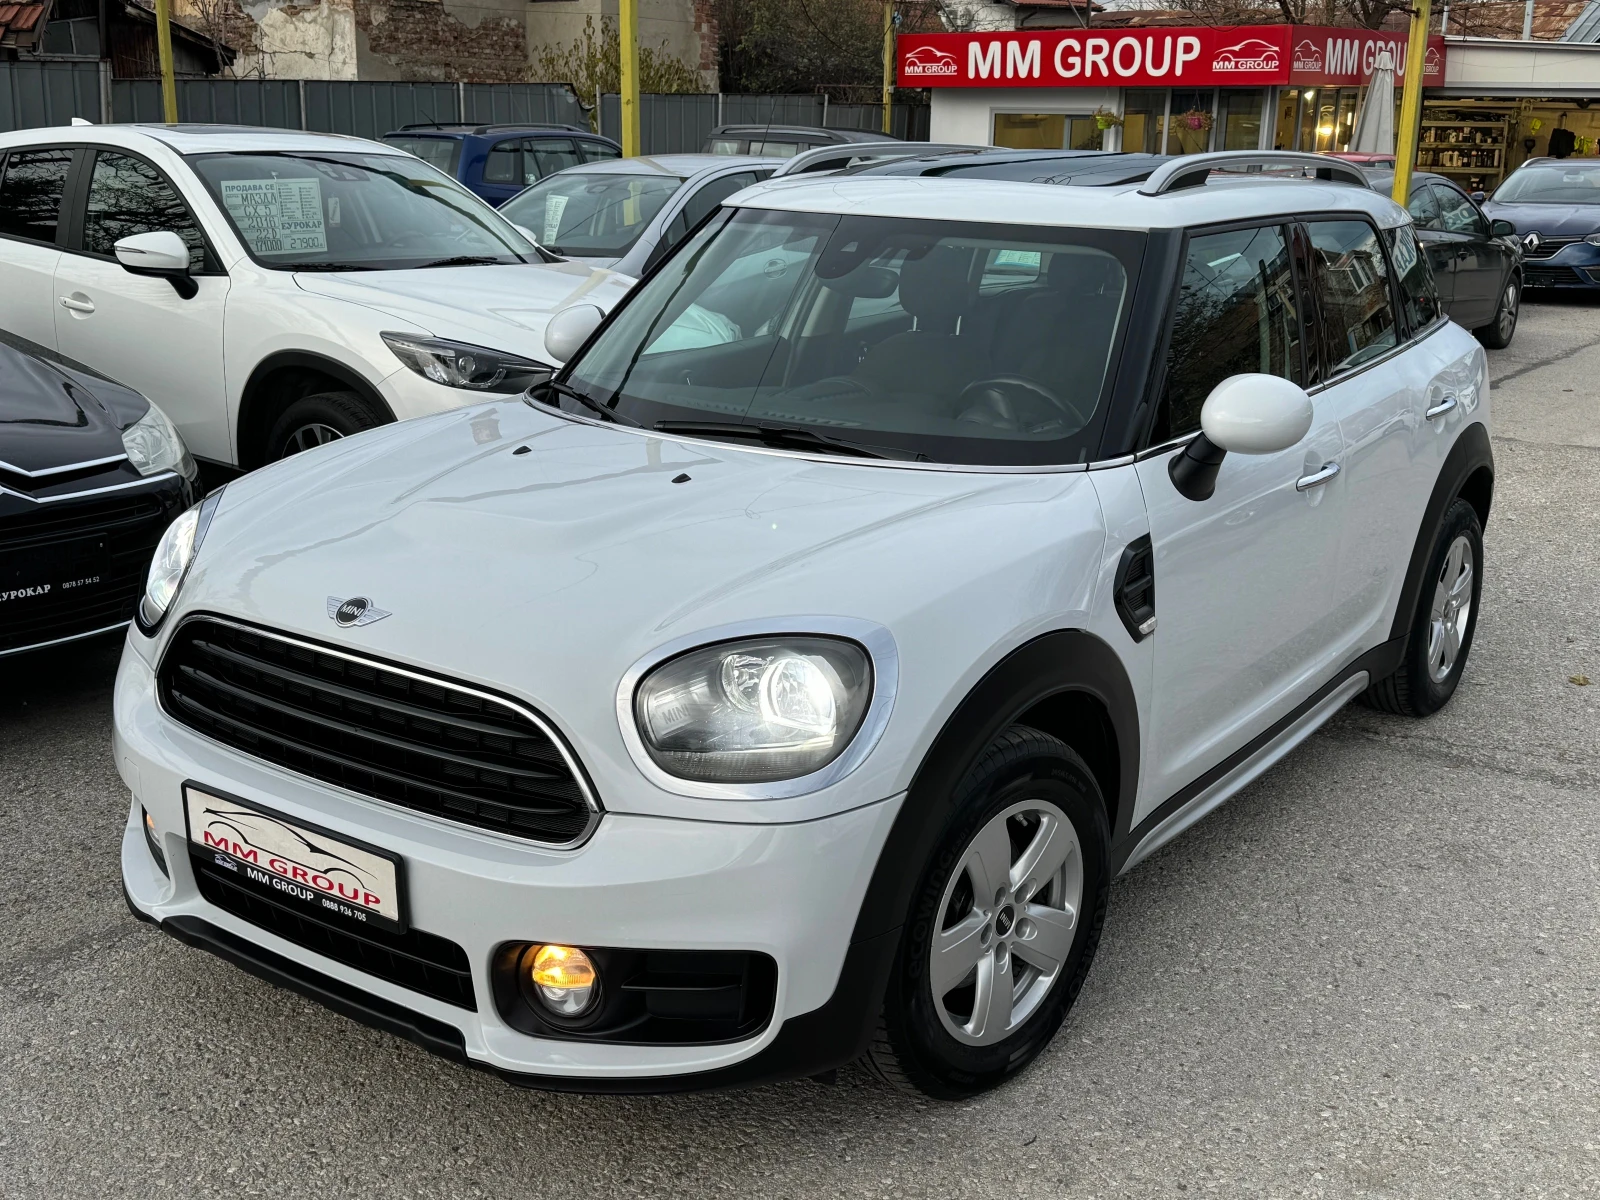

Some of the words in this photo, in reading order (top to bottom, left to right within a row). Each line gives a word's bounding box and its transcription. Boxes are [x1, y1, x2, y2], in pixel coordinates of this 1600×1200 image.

[968, 41, 1041, 79] MM
[1054, 36, 1200, 79] GROUP
[1324, 38, 1359, 76] MM
[1363, 40, 1407, 76] GOU
[905, 65, 923, 73] MM
[925, 65, 957, 74] GROUP
[1212, 60, 1235, 69] MM
[1238, 60, 1279, 69] GROUP
[1293, 61, 1304, 69] MM
[1305, 61, 1322, 70] GROUP
[225, 184, 263, 193] ПРОДАВА
[248, 217, 277, 229] 2016
[281, 221, 322, 230] ЕУРОКАР
[290, 237, 319, 249] 27900
[0, 584, 51, 601] УРОКАР
[62, 581, 76, 589] 0878
[341, 604, 365, 616] MINI
[662, 703, 690, 725] MINI
[203, 830, 259, 864] MM
[269, 858, 381, 906] GROUP
[247, 867, 270, 886] MM
[272, 878, 314, 901] GROUP
[321, 898, 339, 912] 0888
[339, 905, 352, 917] 936
[353, 910, 367, 922] 705
